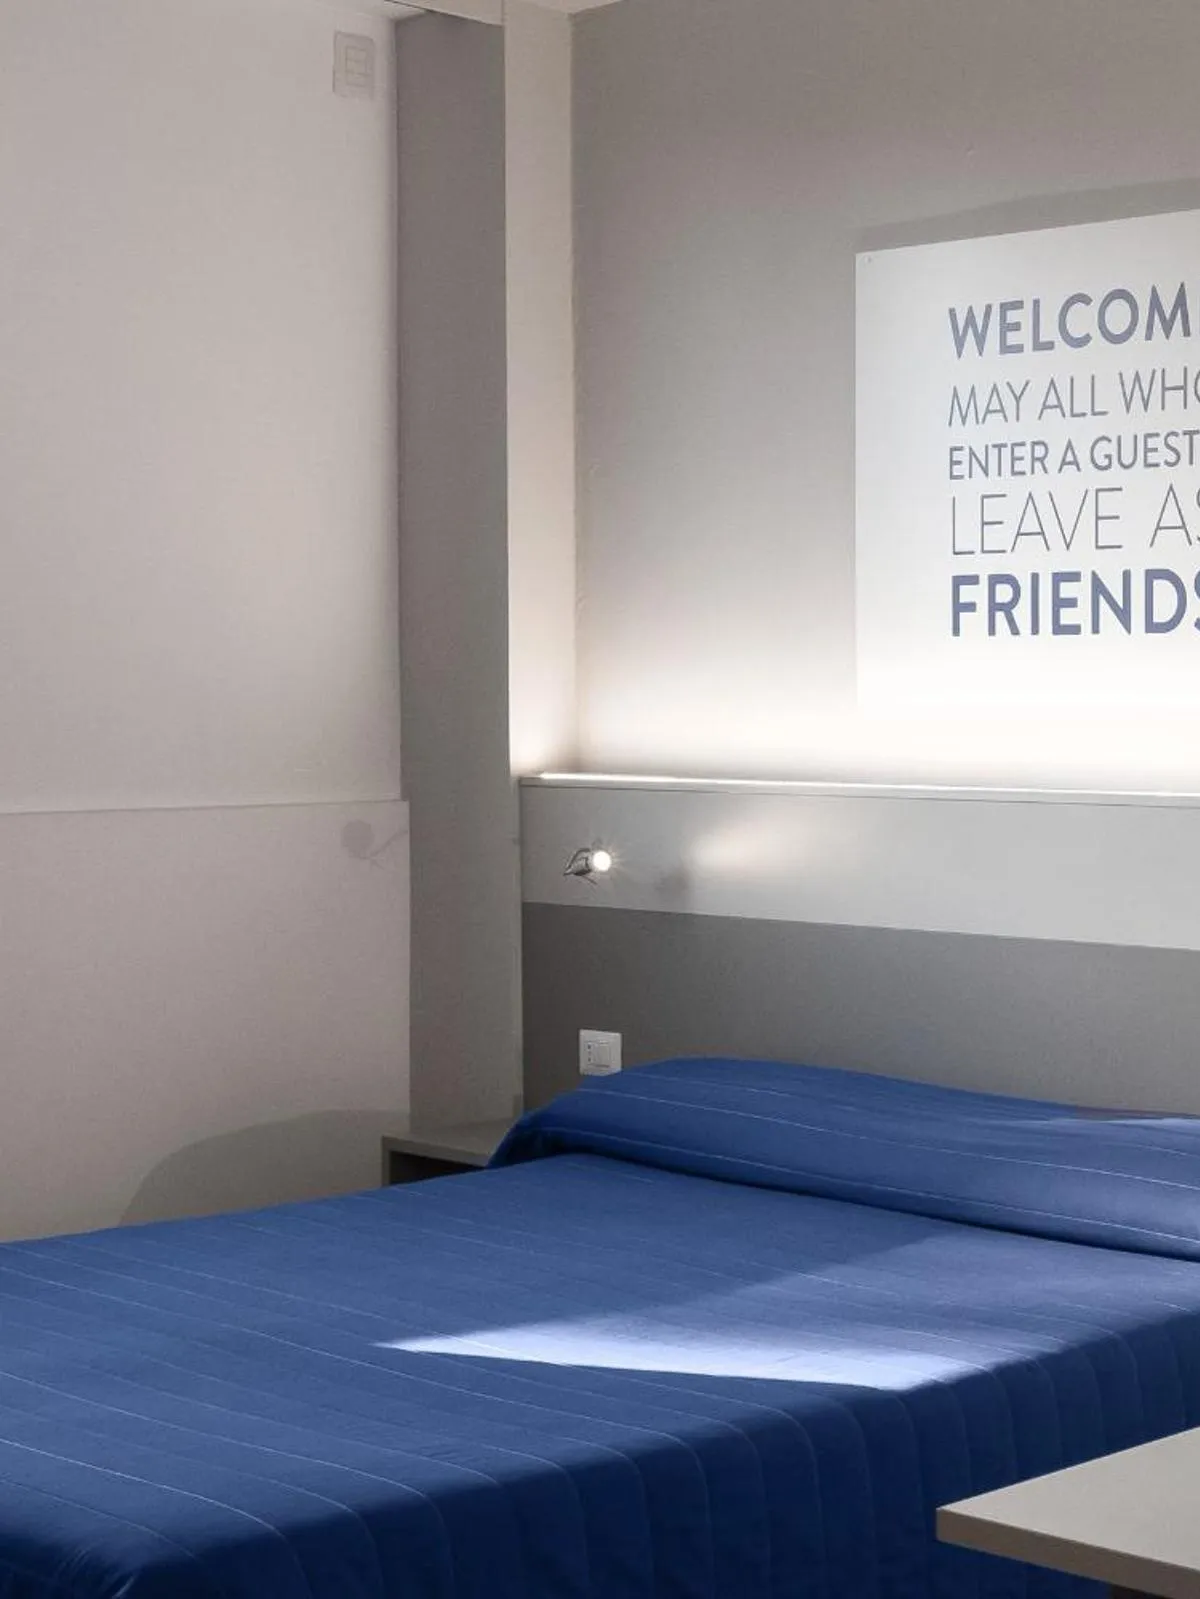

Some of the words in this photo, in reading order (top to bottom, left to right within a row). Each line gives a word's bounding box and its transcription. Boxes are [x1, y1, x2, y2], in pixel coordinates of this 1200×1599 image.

[948, 379, 1030, 427] MAY
[1038, 373, 1109, 421] ALL
[948, 440, 1050, 480] ENTER
[1057, 438, 1082, 474] A
[952, 487, 1124, 556] LEAVE
